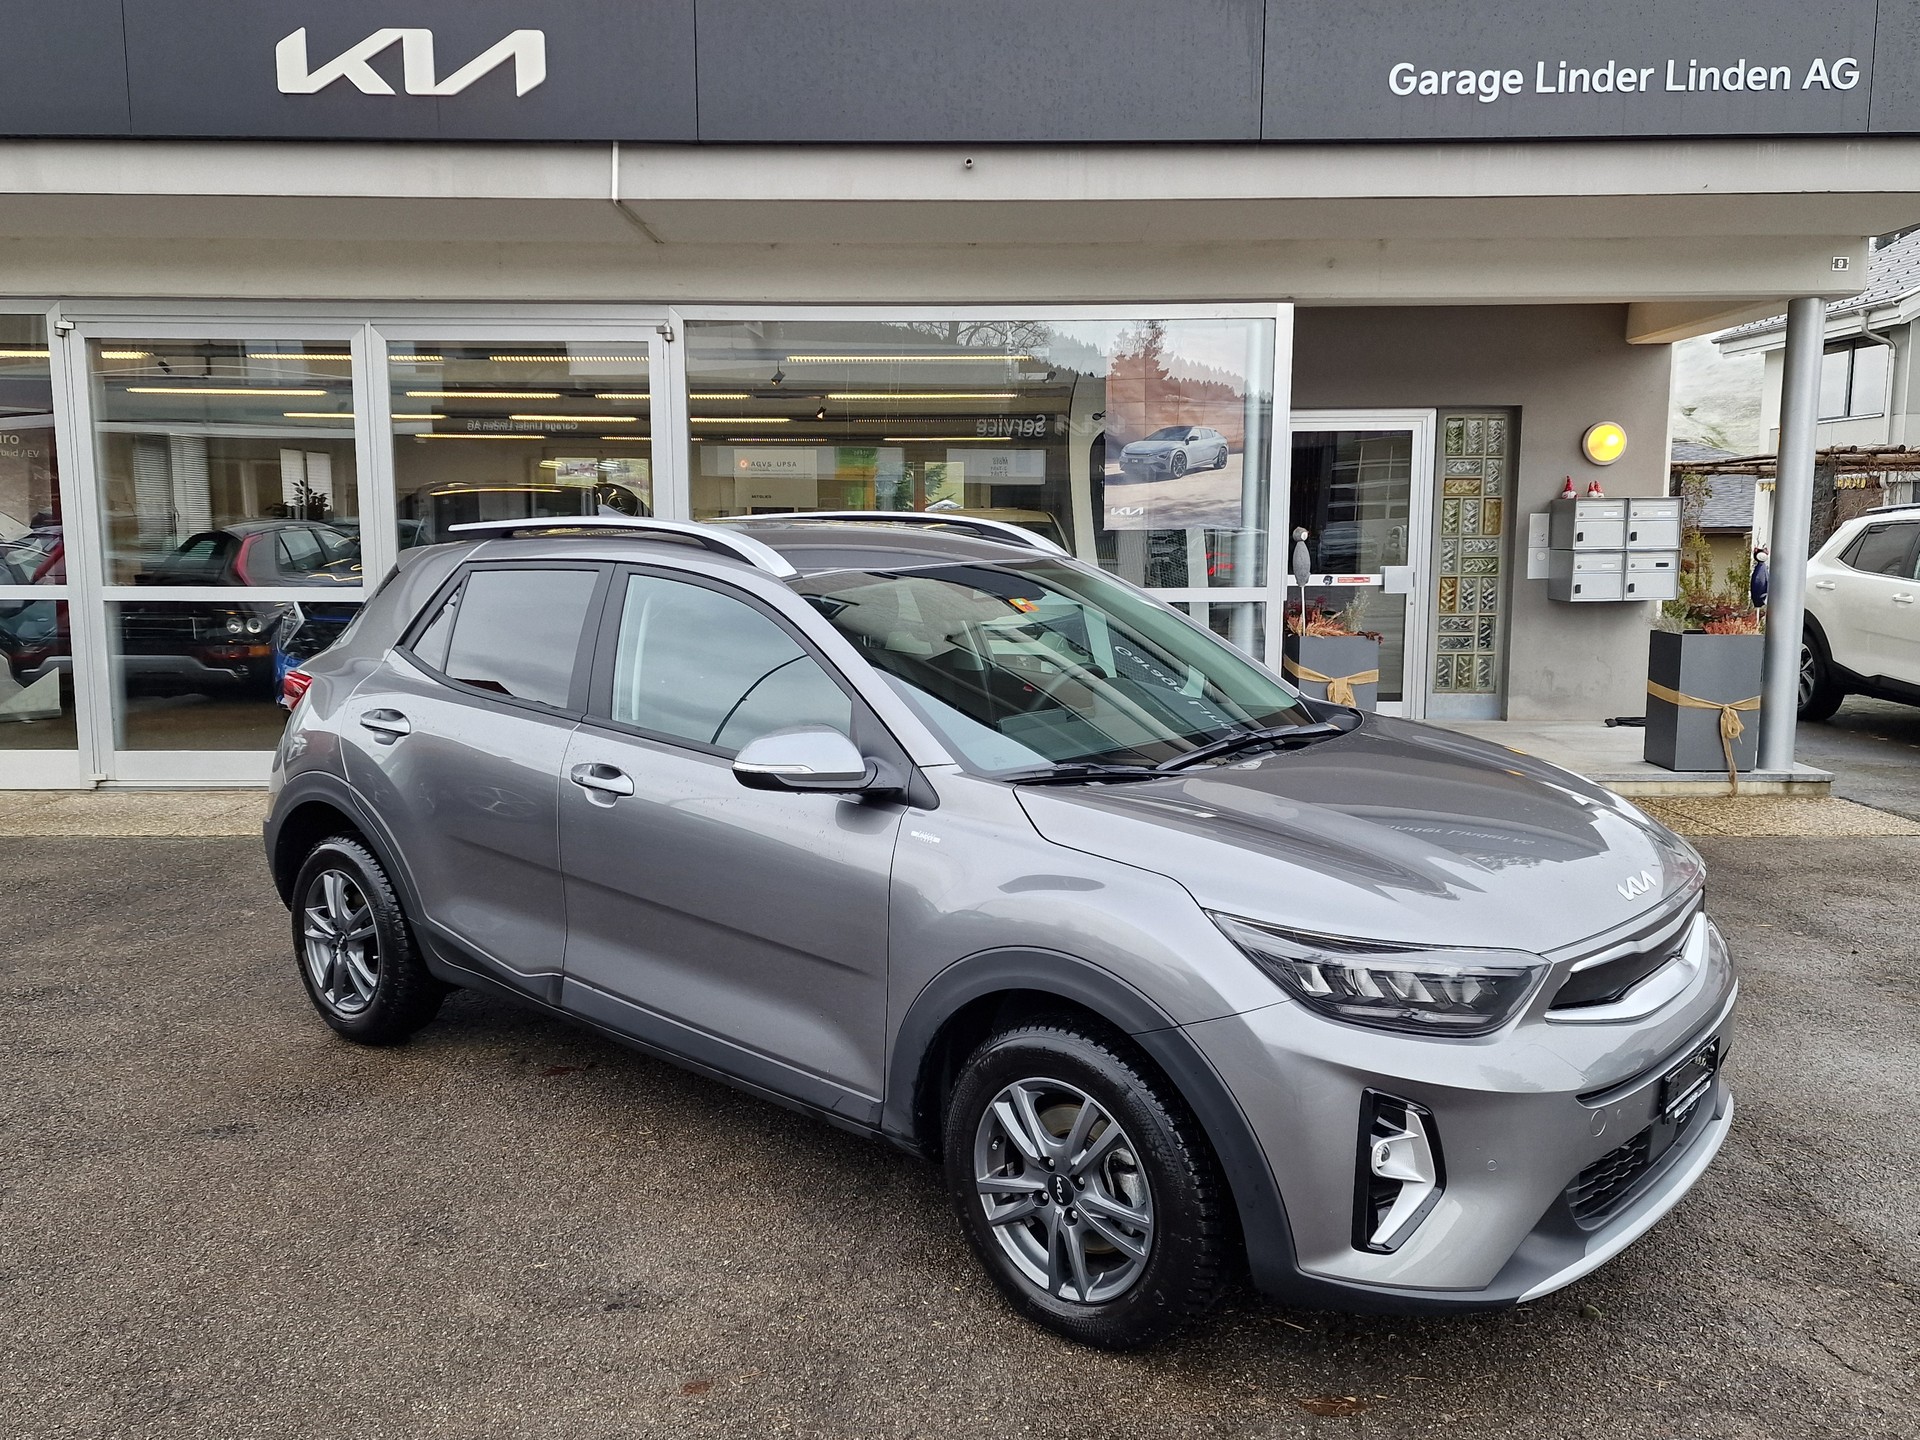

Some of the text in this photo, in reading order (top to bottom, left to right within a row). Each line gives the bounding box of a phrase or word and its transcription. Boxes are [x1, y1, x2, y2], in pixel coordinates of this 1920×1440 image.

[1388, 56, 1861, 103] Garage Linder Linden AG
[1837, 259, 1844, 269] 9
[750, 460, 797, 468] AGVS UPSA
